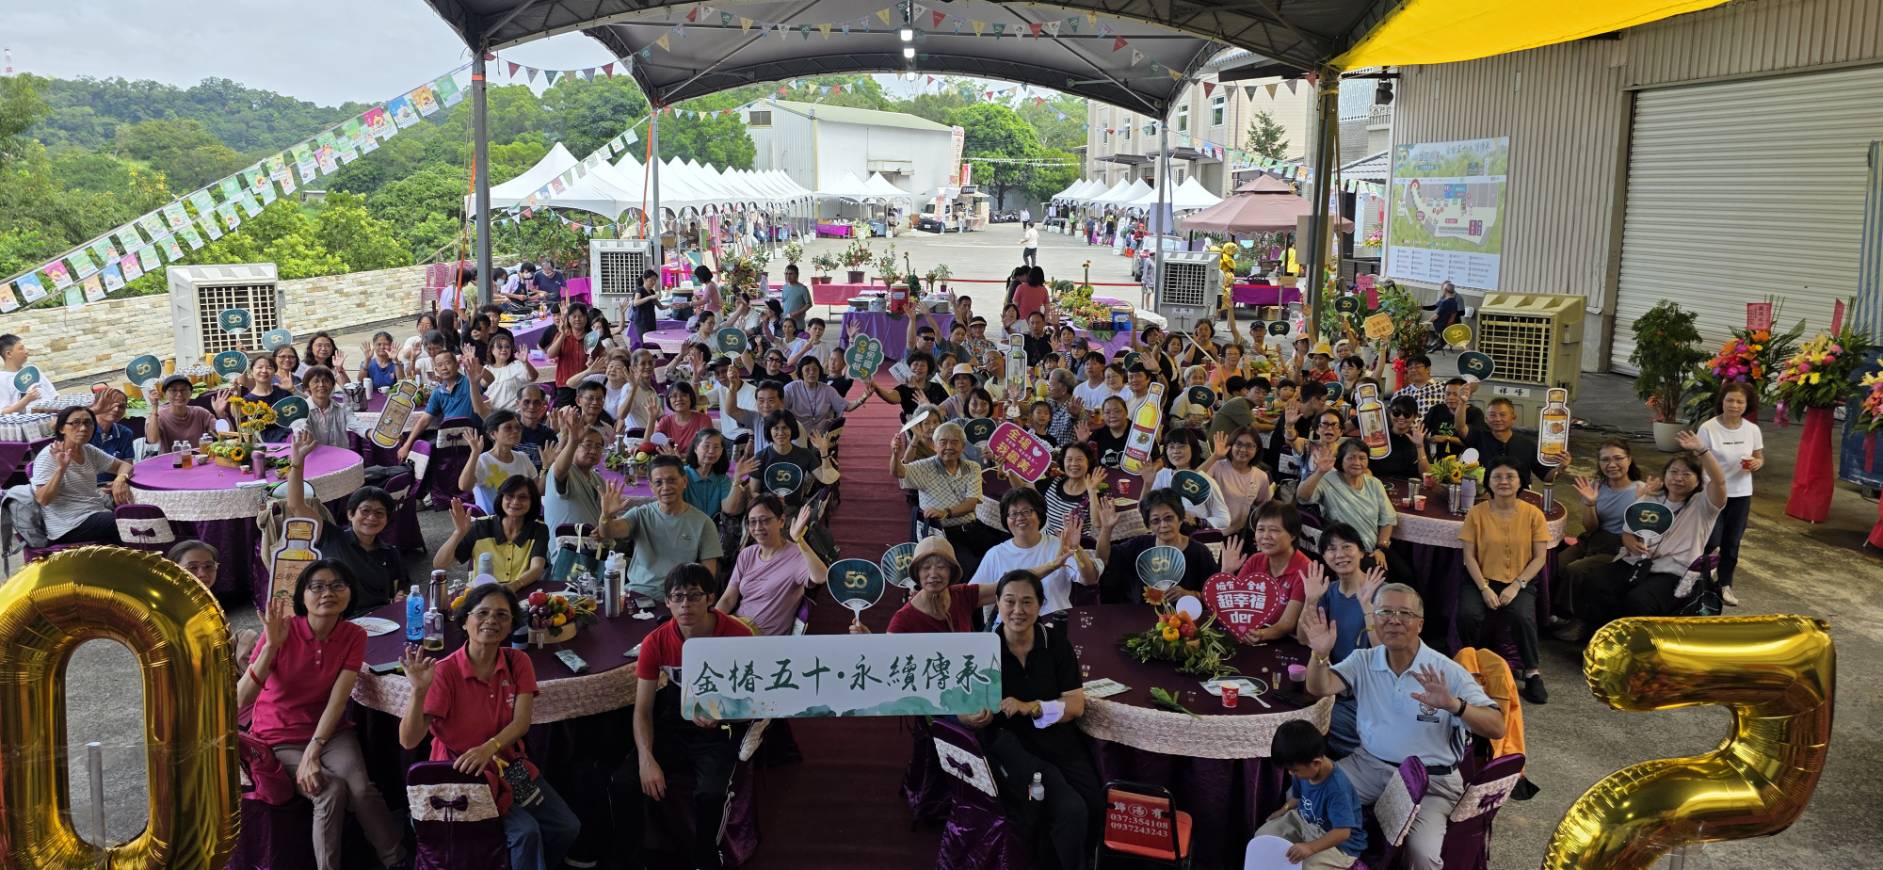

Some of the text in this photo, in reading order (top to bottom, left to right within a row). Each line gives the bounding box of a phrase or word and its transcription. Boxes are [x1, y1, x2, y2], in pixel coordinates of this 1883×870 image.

[136, 364, 151, 375] 50
[776, 470, 791, 481] 50
[1183, 479, 1199, 493] 50
[1639, 510, 1659, 523] 50
[1152, 557, 1169, 572] 50
[844, 571, 867, 588] 50
[1216, 593, 1267, 609] 超幸福
[1230, 611, 1254, 624] der
